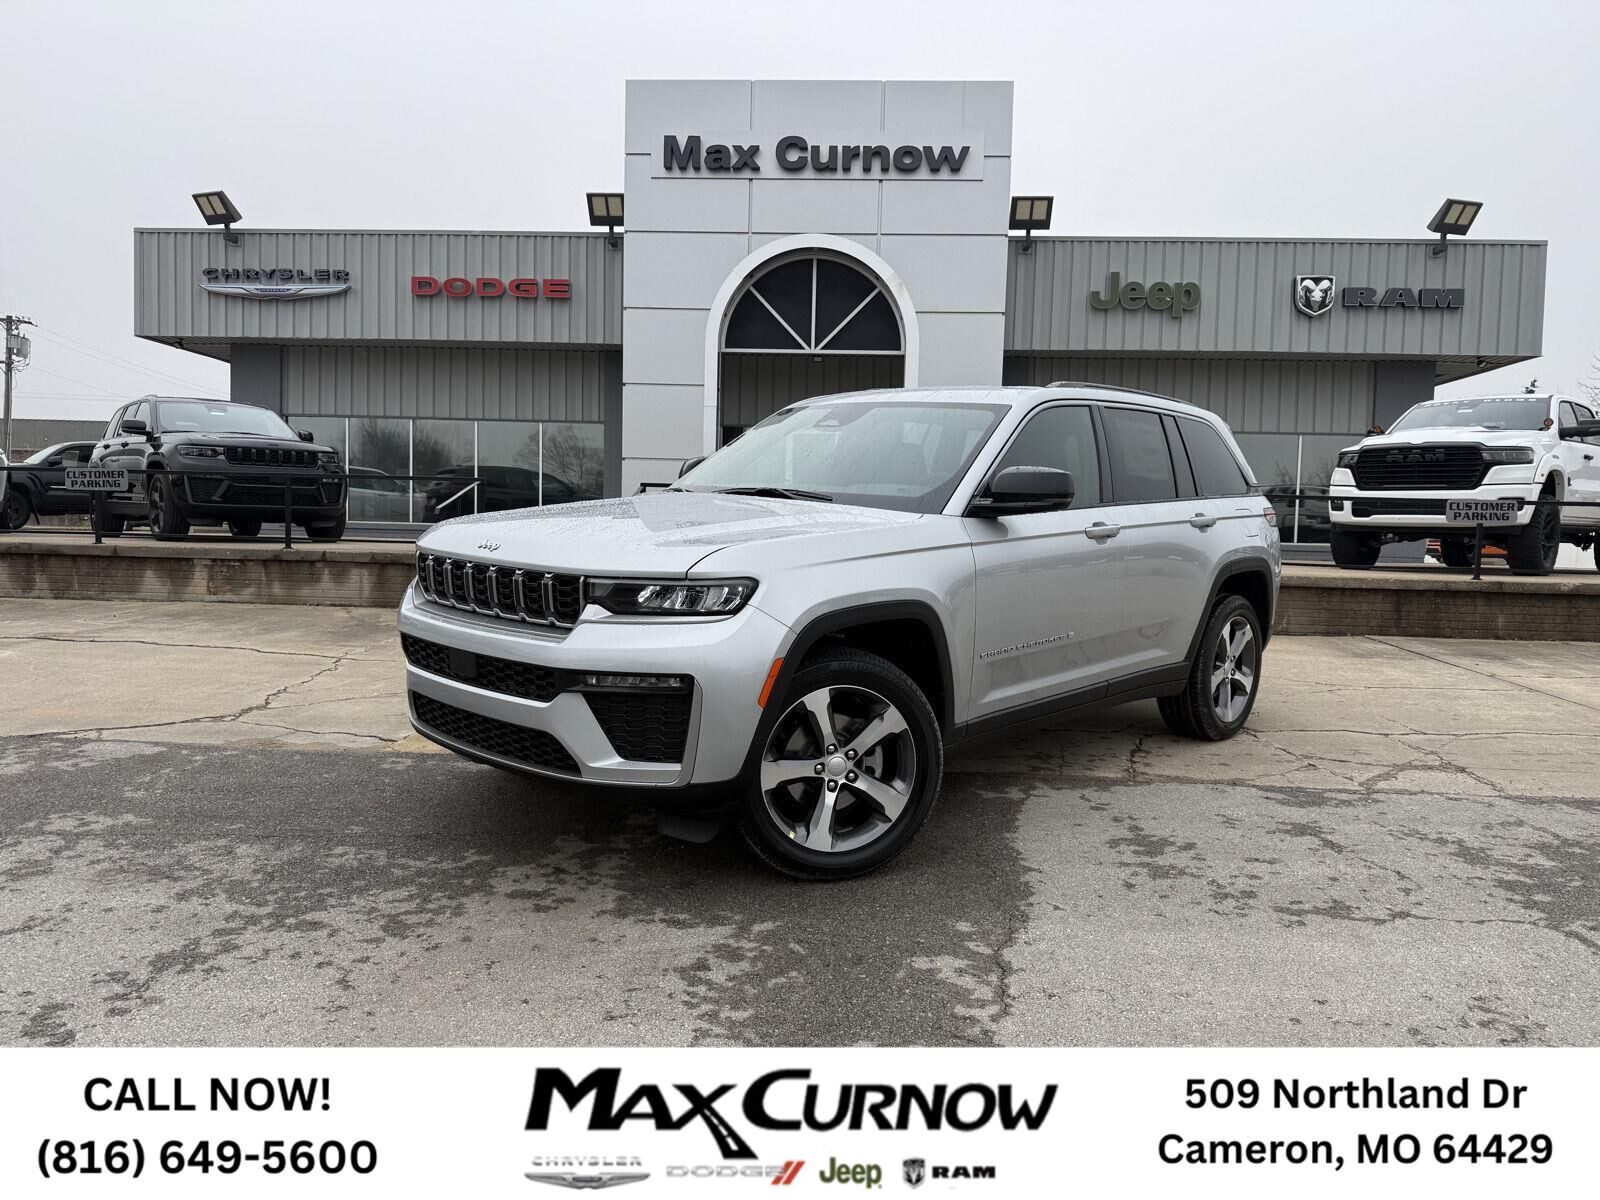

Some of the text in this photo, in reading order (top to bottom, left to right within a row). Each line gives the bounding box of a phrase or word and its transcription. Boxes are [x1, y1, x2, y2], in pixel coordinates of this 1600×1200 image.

[663, 135, 970, 173] Max Curnow
[202, 268, 350, 281] CHRYSLER
[411, 276, 570, 298] DODGE
[1090, 271, 1201, 319] Jeep
[1342, 287, 1465, 308] RAM
[1386, 453, 1445, 463] RAM
[66, 470, 125, 479] CUSTOMER
[70, 479, 121, 488] PARKING
[1449, 502, 1516, 512] CUSTOMER
[1453, 512, 1510, 521] PARKING
